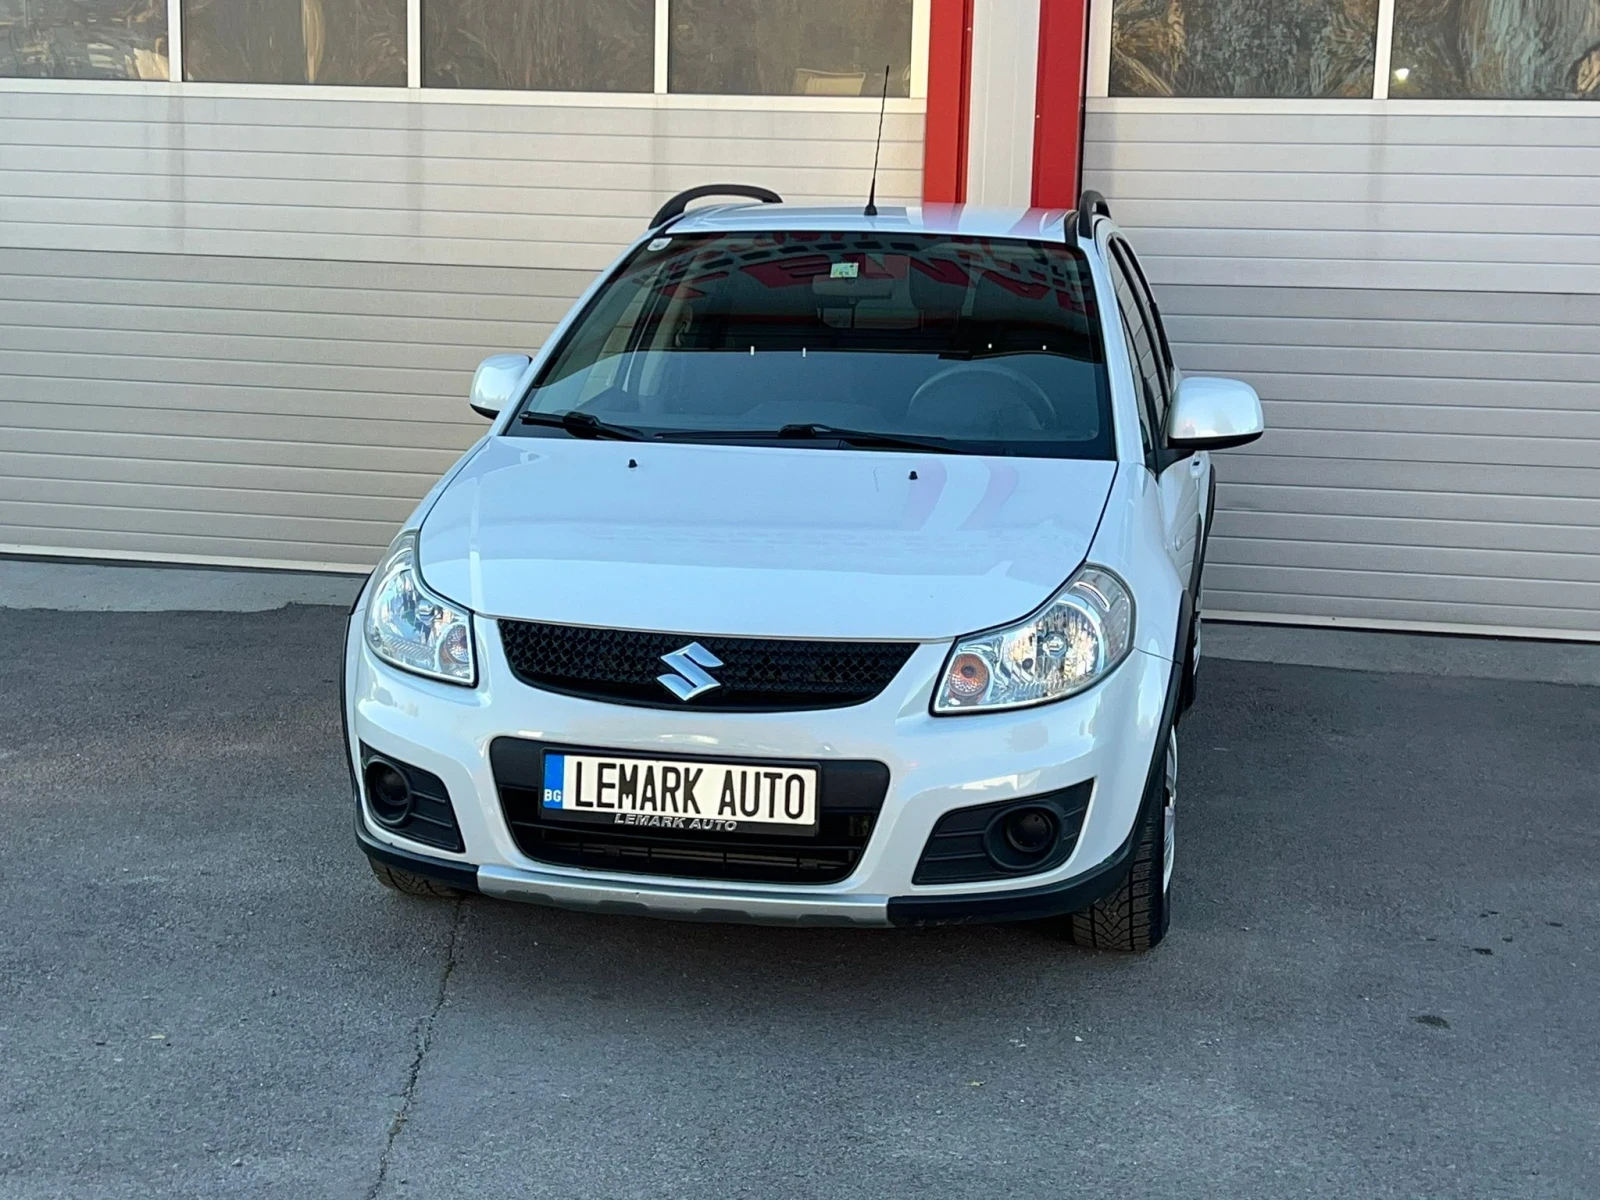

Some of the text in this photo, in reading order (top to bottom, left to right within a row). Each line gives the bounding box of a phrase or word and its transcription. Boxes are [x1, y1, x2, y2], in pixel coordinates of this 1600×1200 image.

[544, 789, 562, 802] BG
[575, 761, 806, 819] LEMARK AUTO
[614, 813, 737, 832] LEMARK AUTO
